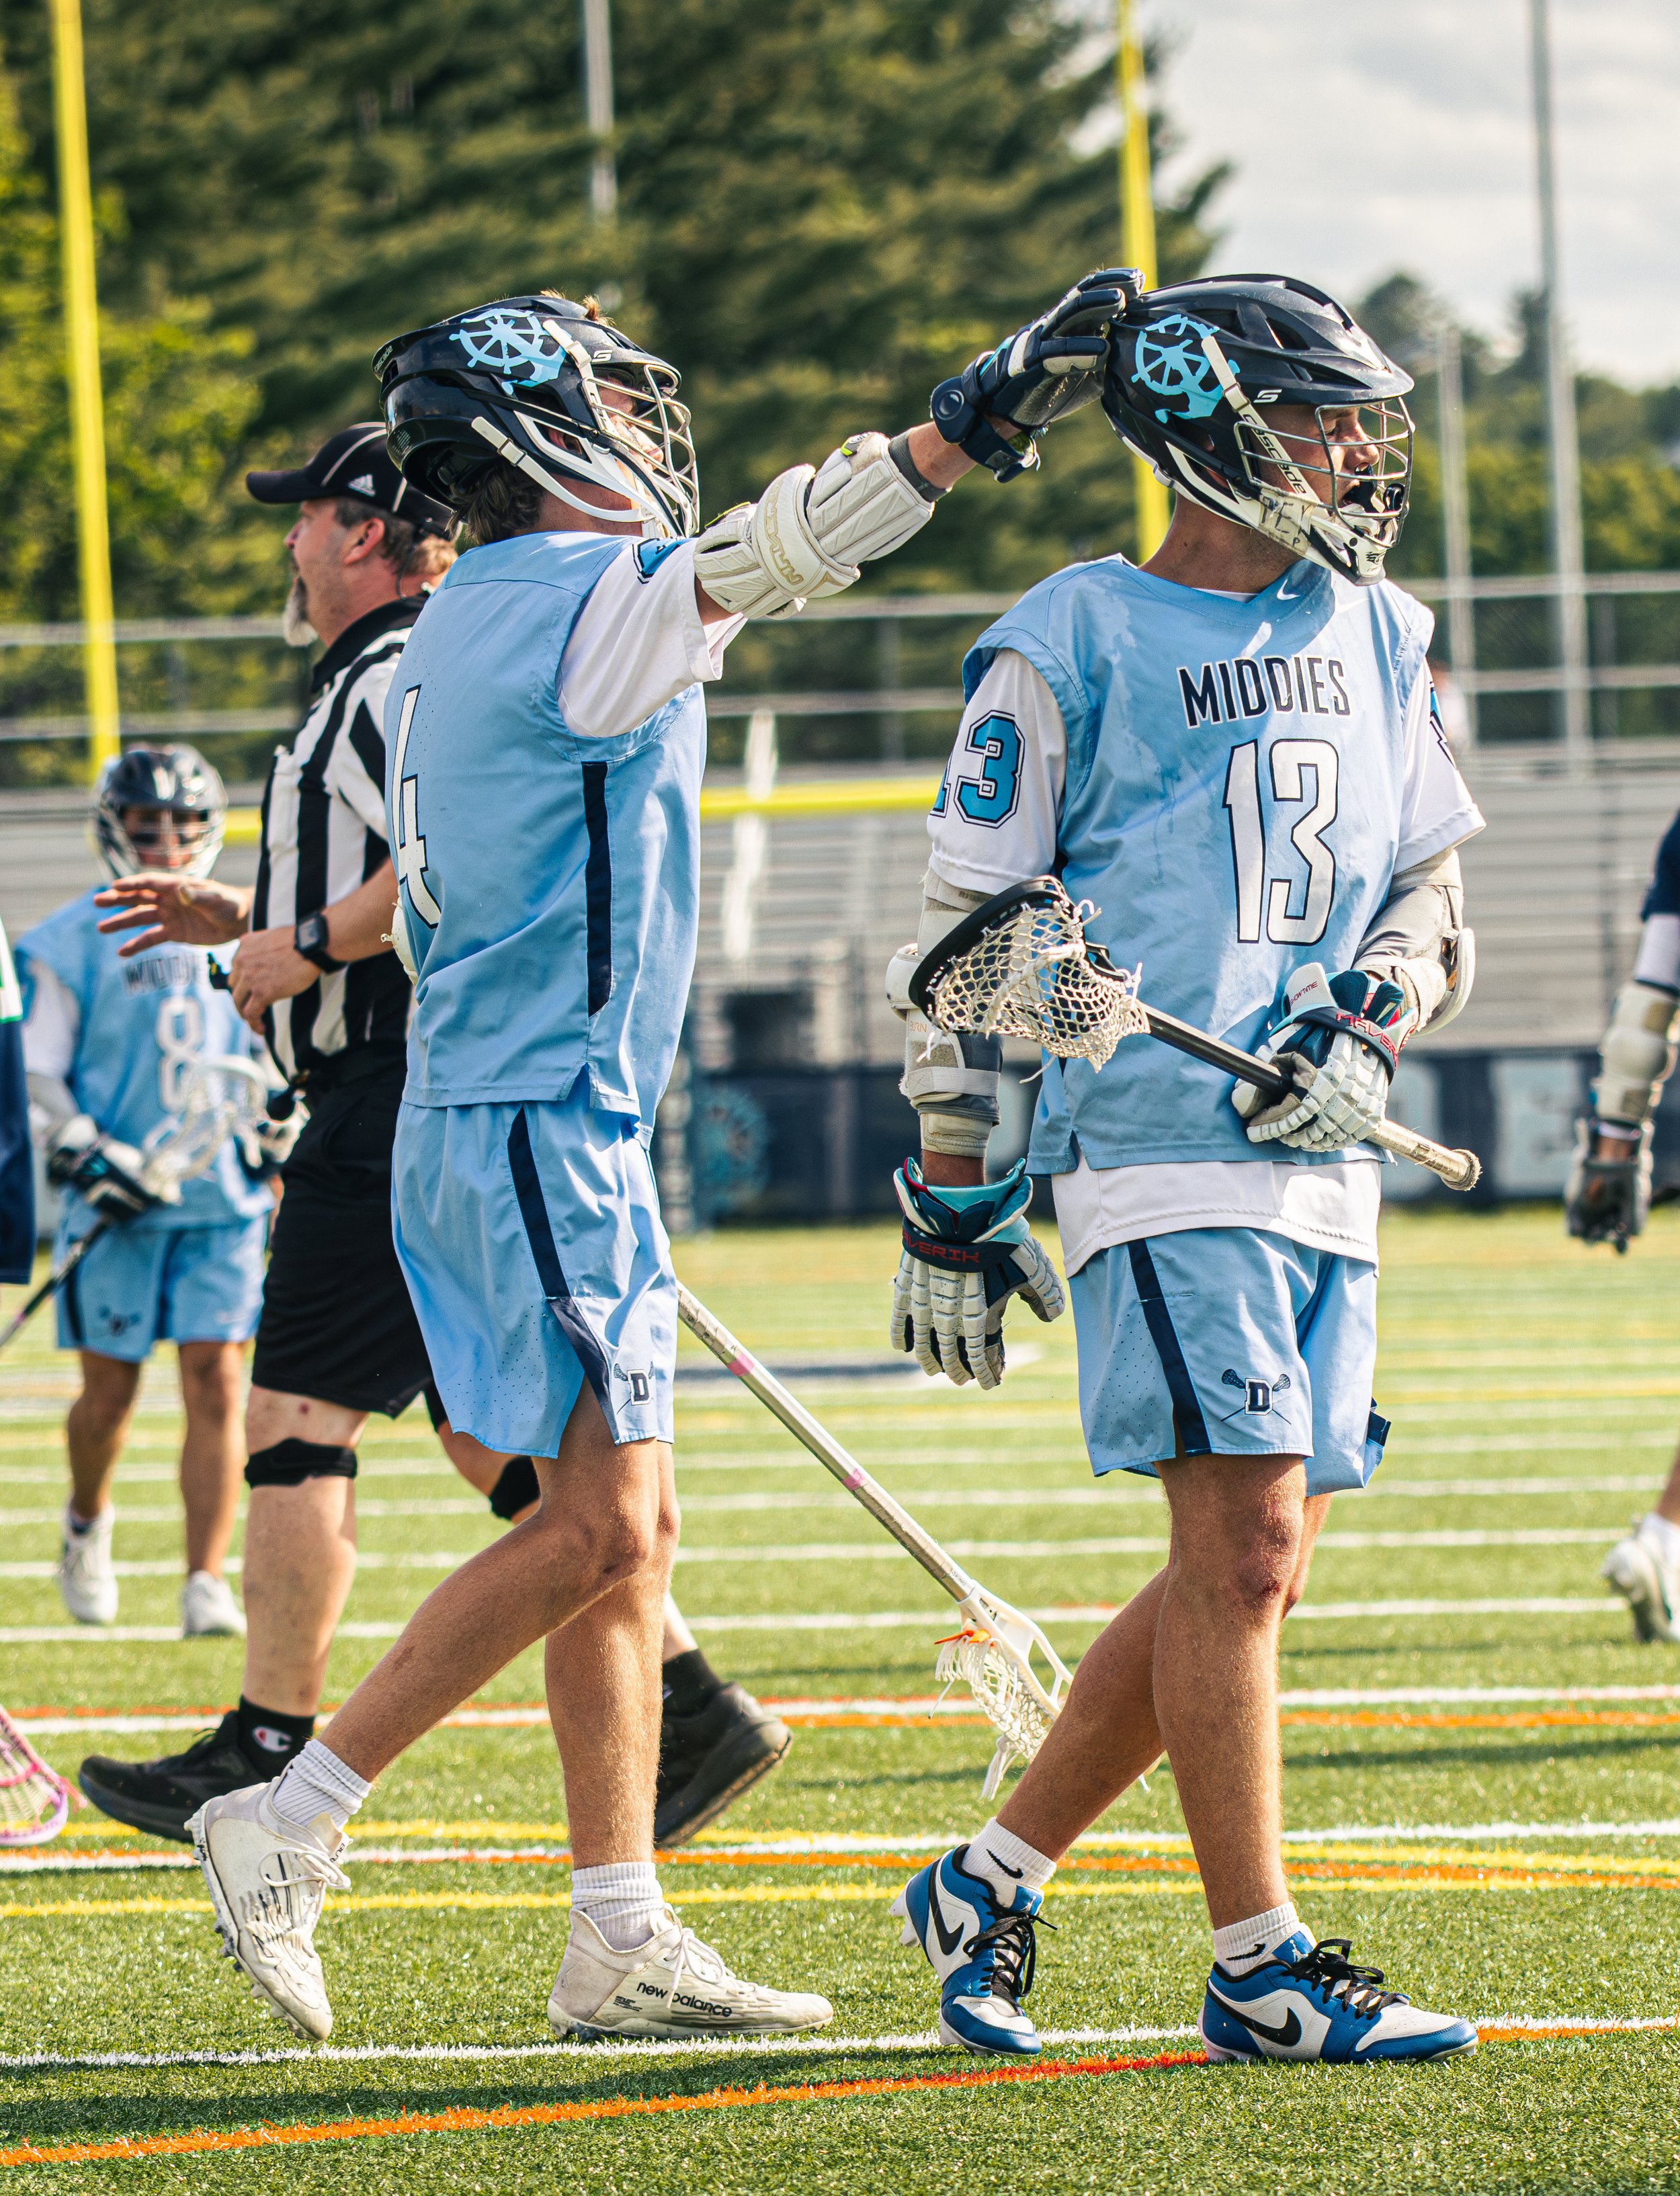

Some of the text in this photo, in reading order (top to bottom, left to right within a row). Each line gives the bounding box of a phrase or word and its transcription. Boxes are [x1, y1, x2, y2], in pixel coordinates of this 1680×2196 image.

[1175, 654, 1351, 730] MIDDIES
[391, 683, 442, 930] 4
[1221, 738, 1339, 946] 13
[156, 996, 202, 1112] 8
[627, 1369, 653, 1406] D
[1244, 1378, 1273, 1416] D
[636, 1982, 668, 1999] new
